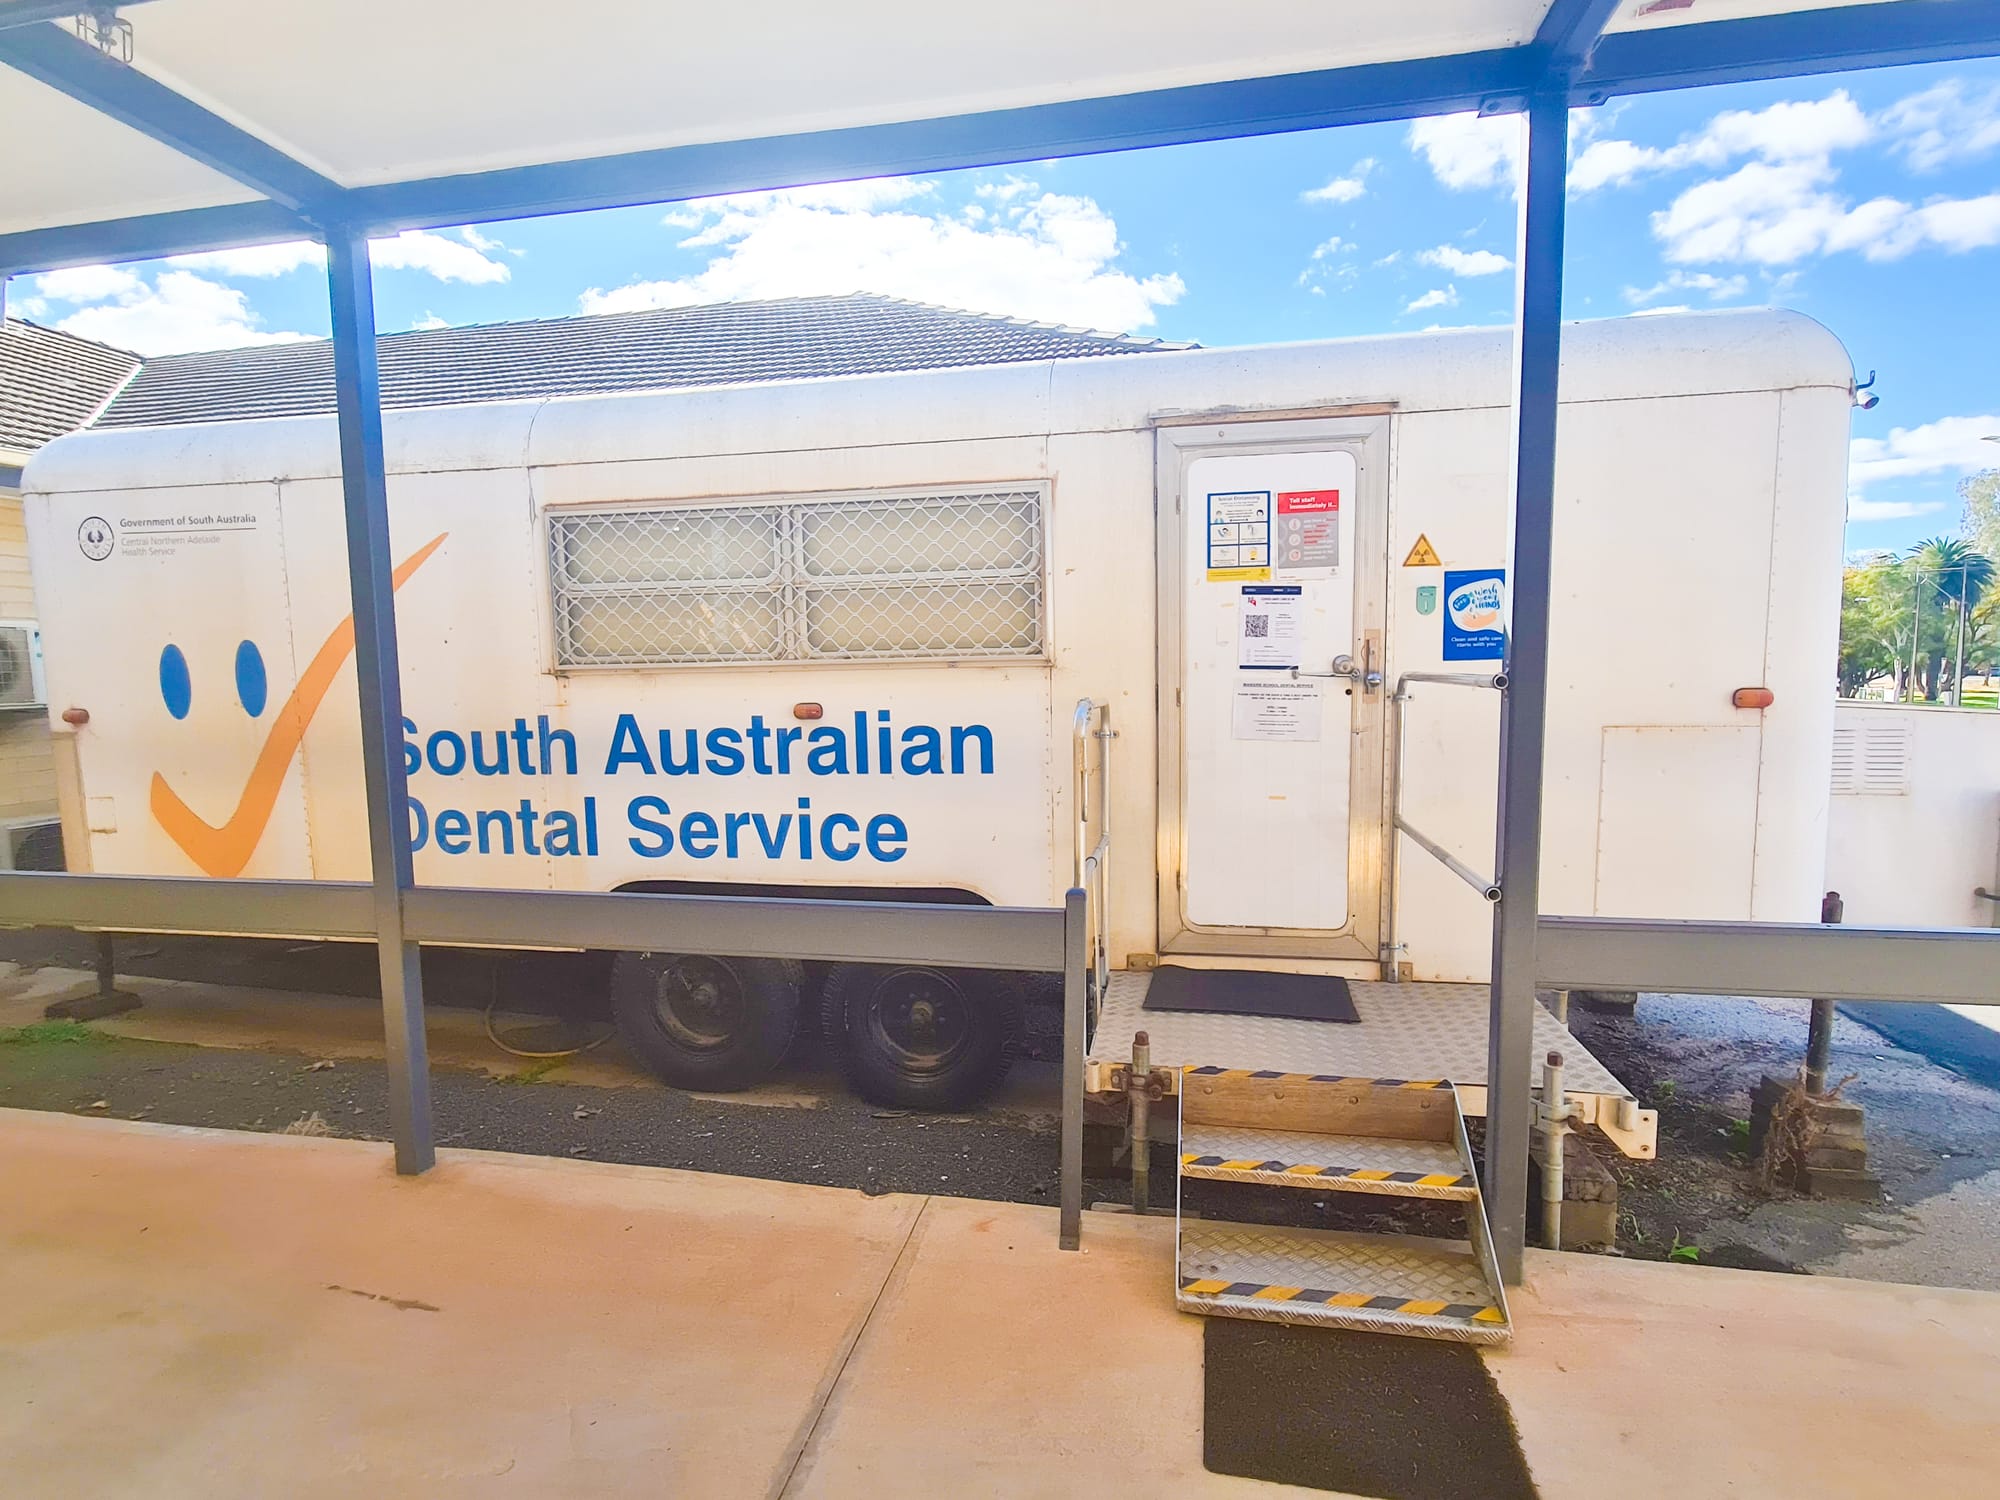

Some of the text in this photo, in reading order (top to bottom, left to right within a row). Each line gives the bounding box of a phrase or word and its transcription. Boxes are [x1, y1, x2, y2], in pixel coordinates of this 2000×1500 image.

[120, 514, 257, 528] Government of South Australia
[121, 533, 222, 547] Central Northern Adelaide
[149, 545, 176, 556] Service
[604, 709, 994, 776] Australian
[627, 795, 909, 863] Service
